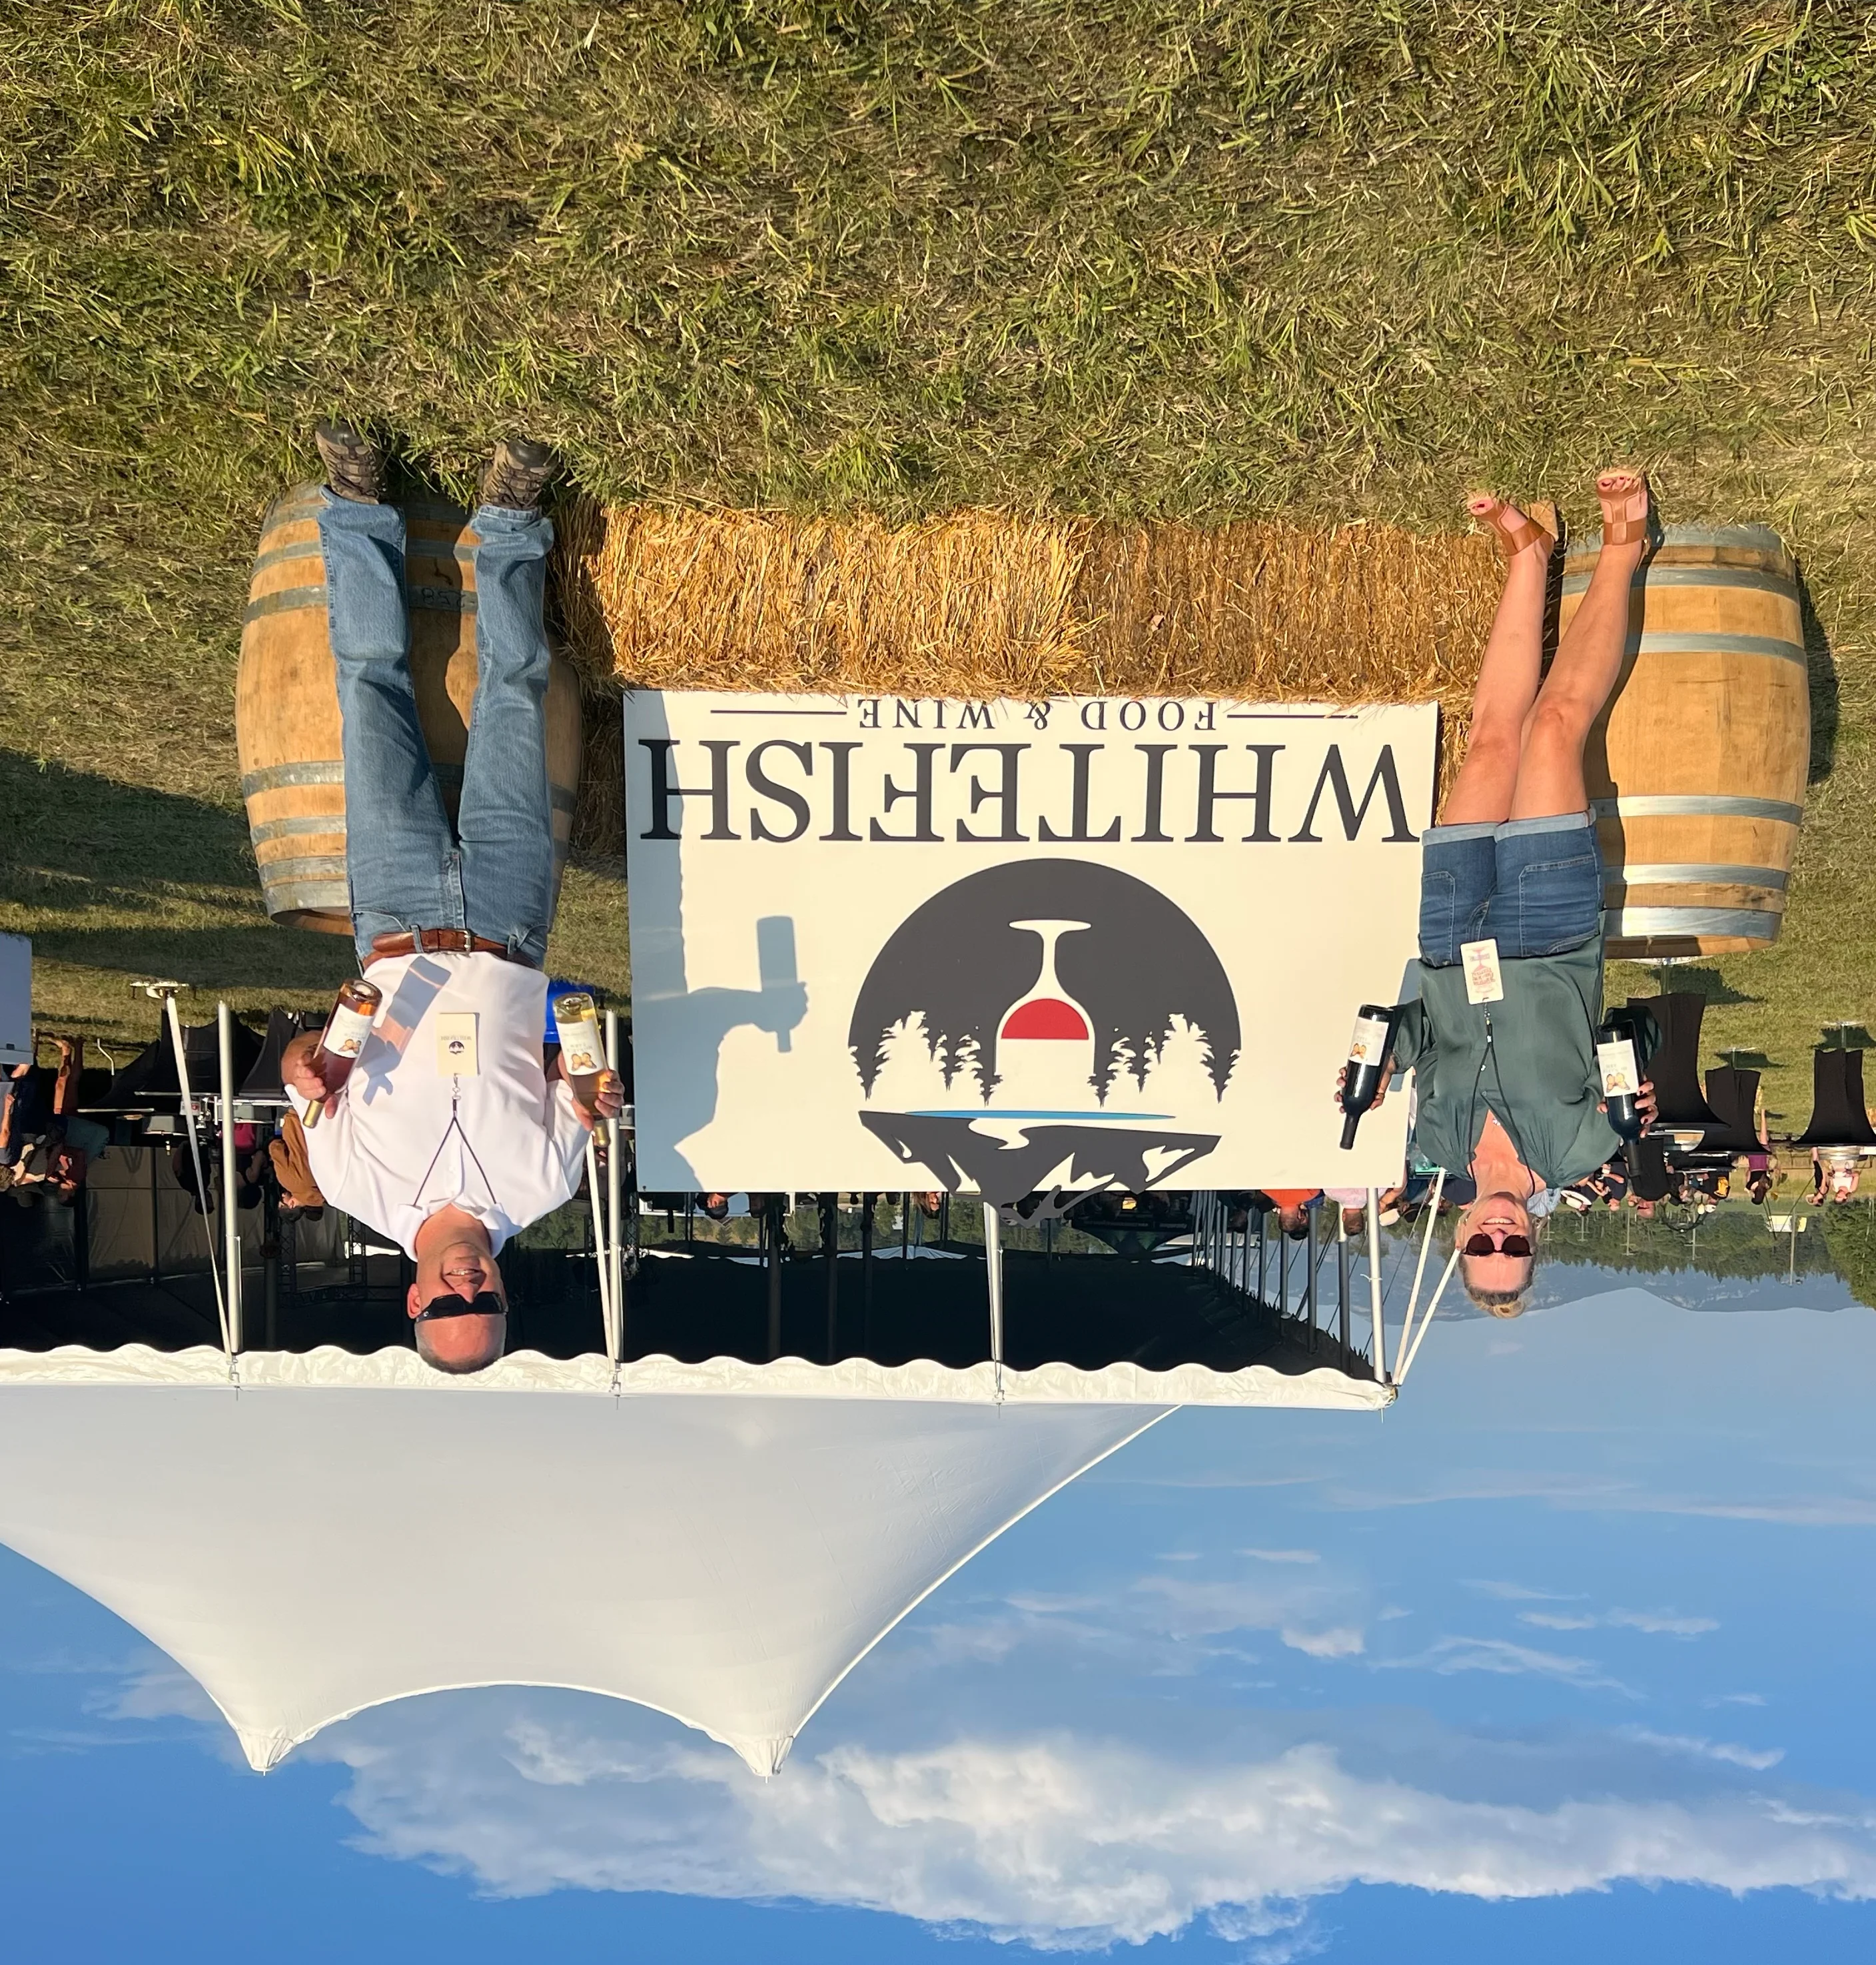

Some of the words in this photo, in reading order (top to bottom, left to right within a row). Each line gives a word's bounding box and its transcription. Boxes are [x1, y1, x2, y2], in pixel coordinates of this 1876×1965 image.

[857, 698, 996, 730] WINE
[1023, 700, 1051, 731] &
[1081, 700, 1217, 731] FOOD
[638, 739, 1420, 842] WHITEFISH
